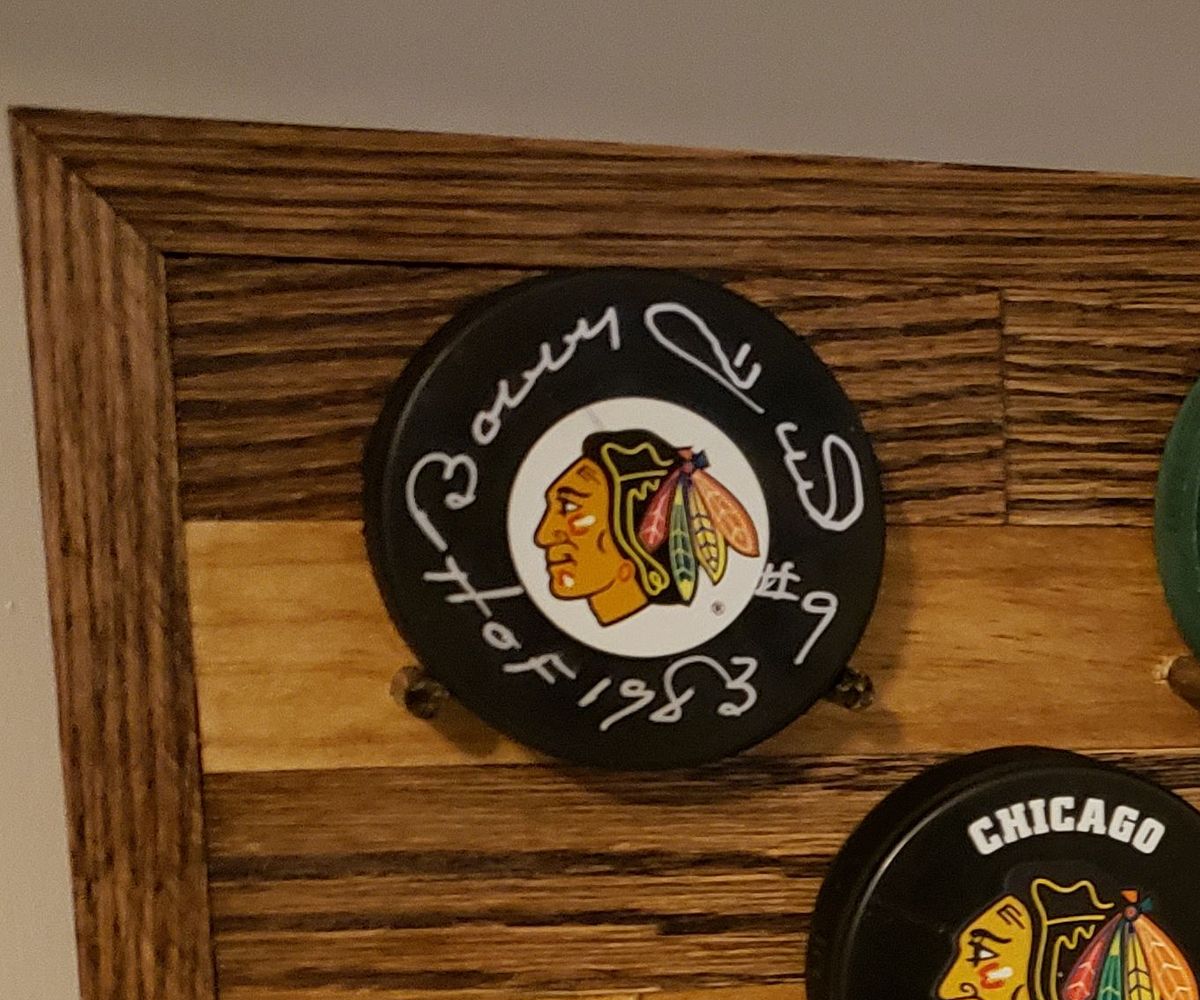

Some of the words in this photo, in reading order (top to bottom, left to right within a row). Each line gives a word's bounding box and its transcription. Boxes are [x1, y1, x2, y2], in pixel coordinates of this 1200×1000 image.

[756, 560, 839, 665] #9
[578, 654, 759, 732] 1983
[968, 796, 1166, 855] CHICAGO
